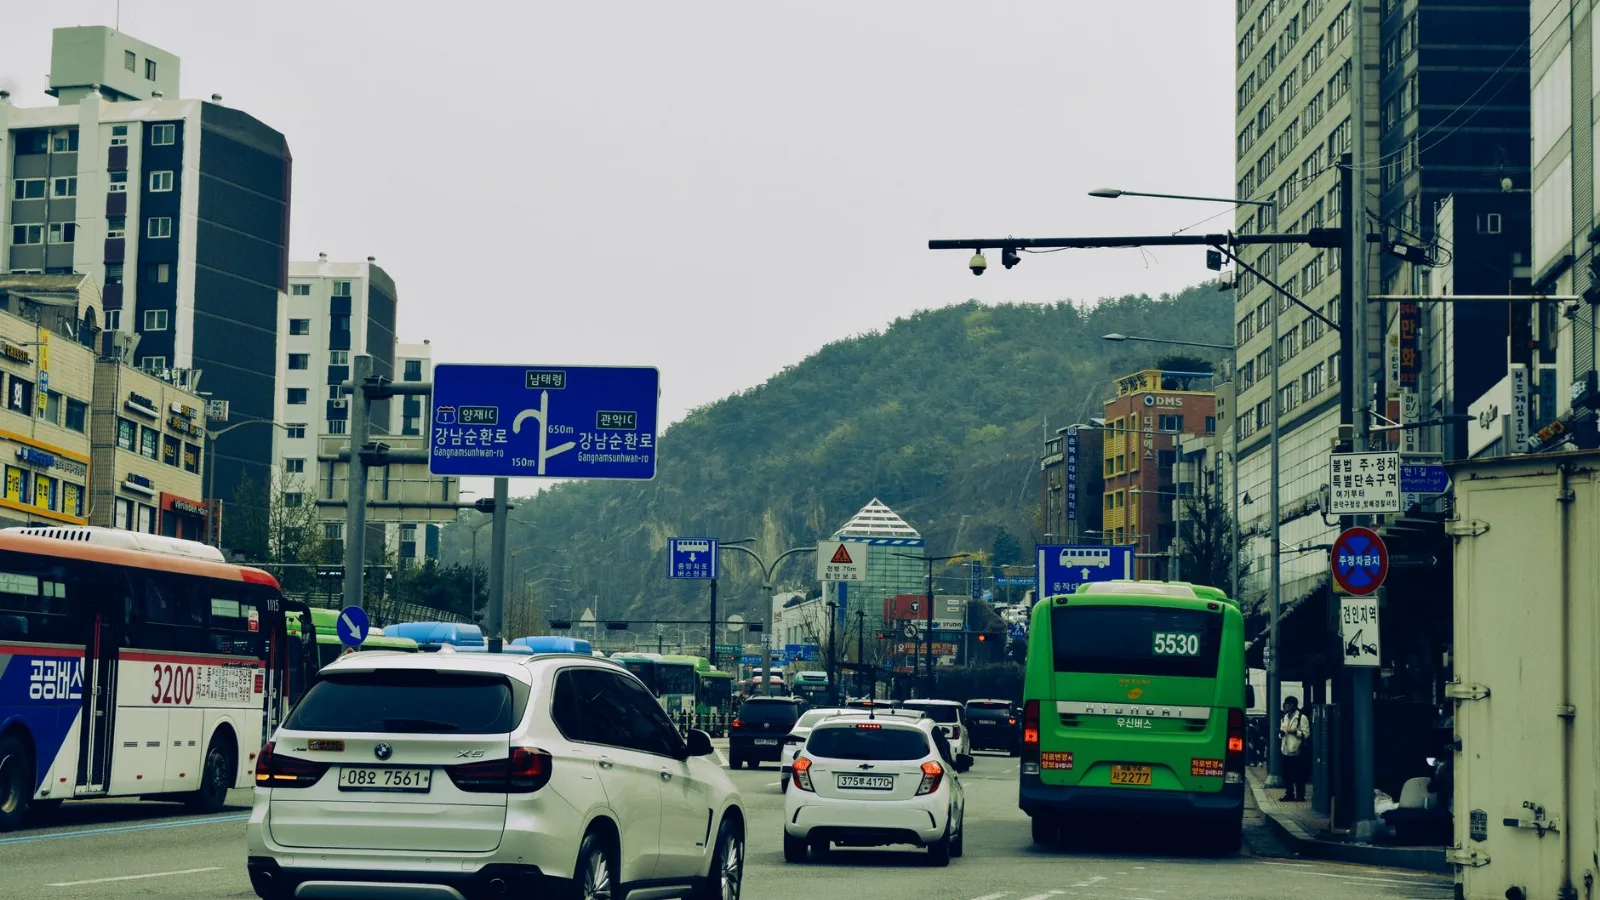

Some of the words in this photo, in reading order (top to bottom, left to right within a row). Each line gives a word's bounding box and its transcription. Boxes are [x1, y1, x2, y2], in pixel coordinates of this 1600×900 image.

[530, 373, 562, 387] 남태령
[1156, 396, 1183, 406] DMS
[443, 413, 448, 422] 1
[462, 409, 494, 421] 양재IC
[600, 413, 633, 426] 관악IC
[435, 427, 508, 445] 강남순환로
[548, 424, 574, 435] 650m
[579, 432, 653, 450] 강남순환로
[1143, 416, 1154, 459] 디엠에스
[433, 446, 504, 459] Gangnamsunhwan-ro
[578, 452, 649, 465] Gangnamsunhwan-ro
[511, 457, 536, 468] 150m
[1332, 458, 1353, 473] 불법
[1401, 467, 1427, 477] 현1길
[1332, 473, 1397, 489] 특별단속구역
[1336, 490, 1365, 499] 여기부터
[1385, 490, 1393, 498] m
[677, 562, 708, 570] 중앙차로
[1338, 554, 1380, 567] 주정차금지
[1343, 604, 1377, 624] 견인지역
[1153, 632, 1199, 655] 5530
[29, 659, 85, 700] 공공버스
[151, 663, 194, 705] 3200
[1085, 703, 1183, 717] HYUNDAI
[1116, 717, 1152, 729] 우신버스
[456, 749, 486, 759] X5
[347, 770, 377, 785] 08오
[384, 770, 421, 786] 7561
[866, 777, 889, 787] 4170
